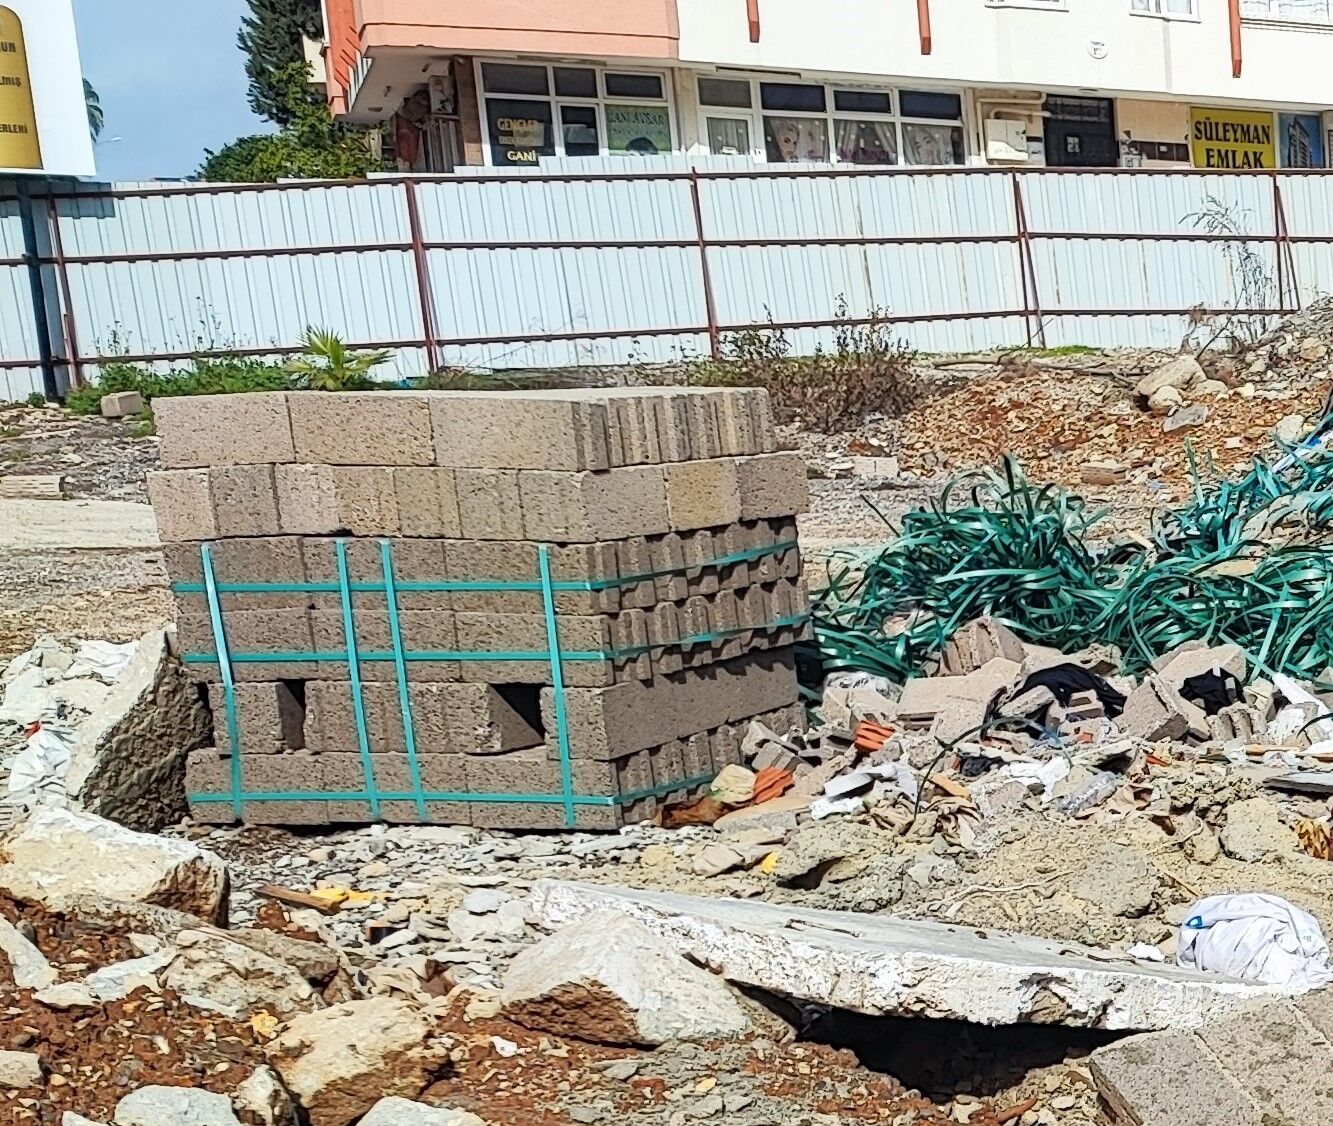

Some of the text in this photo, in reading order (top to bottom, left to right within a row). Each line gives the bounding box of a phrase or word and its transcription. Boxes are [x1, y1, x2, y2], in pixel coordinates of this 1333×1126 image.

[0, 42, 16, 53] UN
[1194, 117, 1271, 145] SÜLEYMAN
[507, 150, 537, 162] GANİ
[1205, 148, 1265, 168] EMLAK
